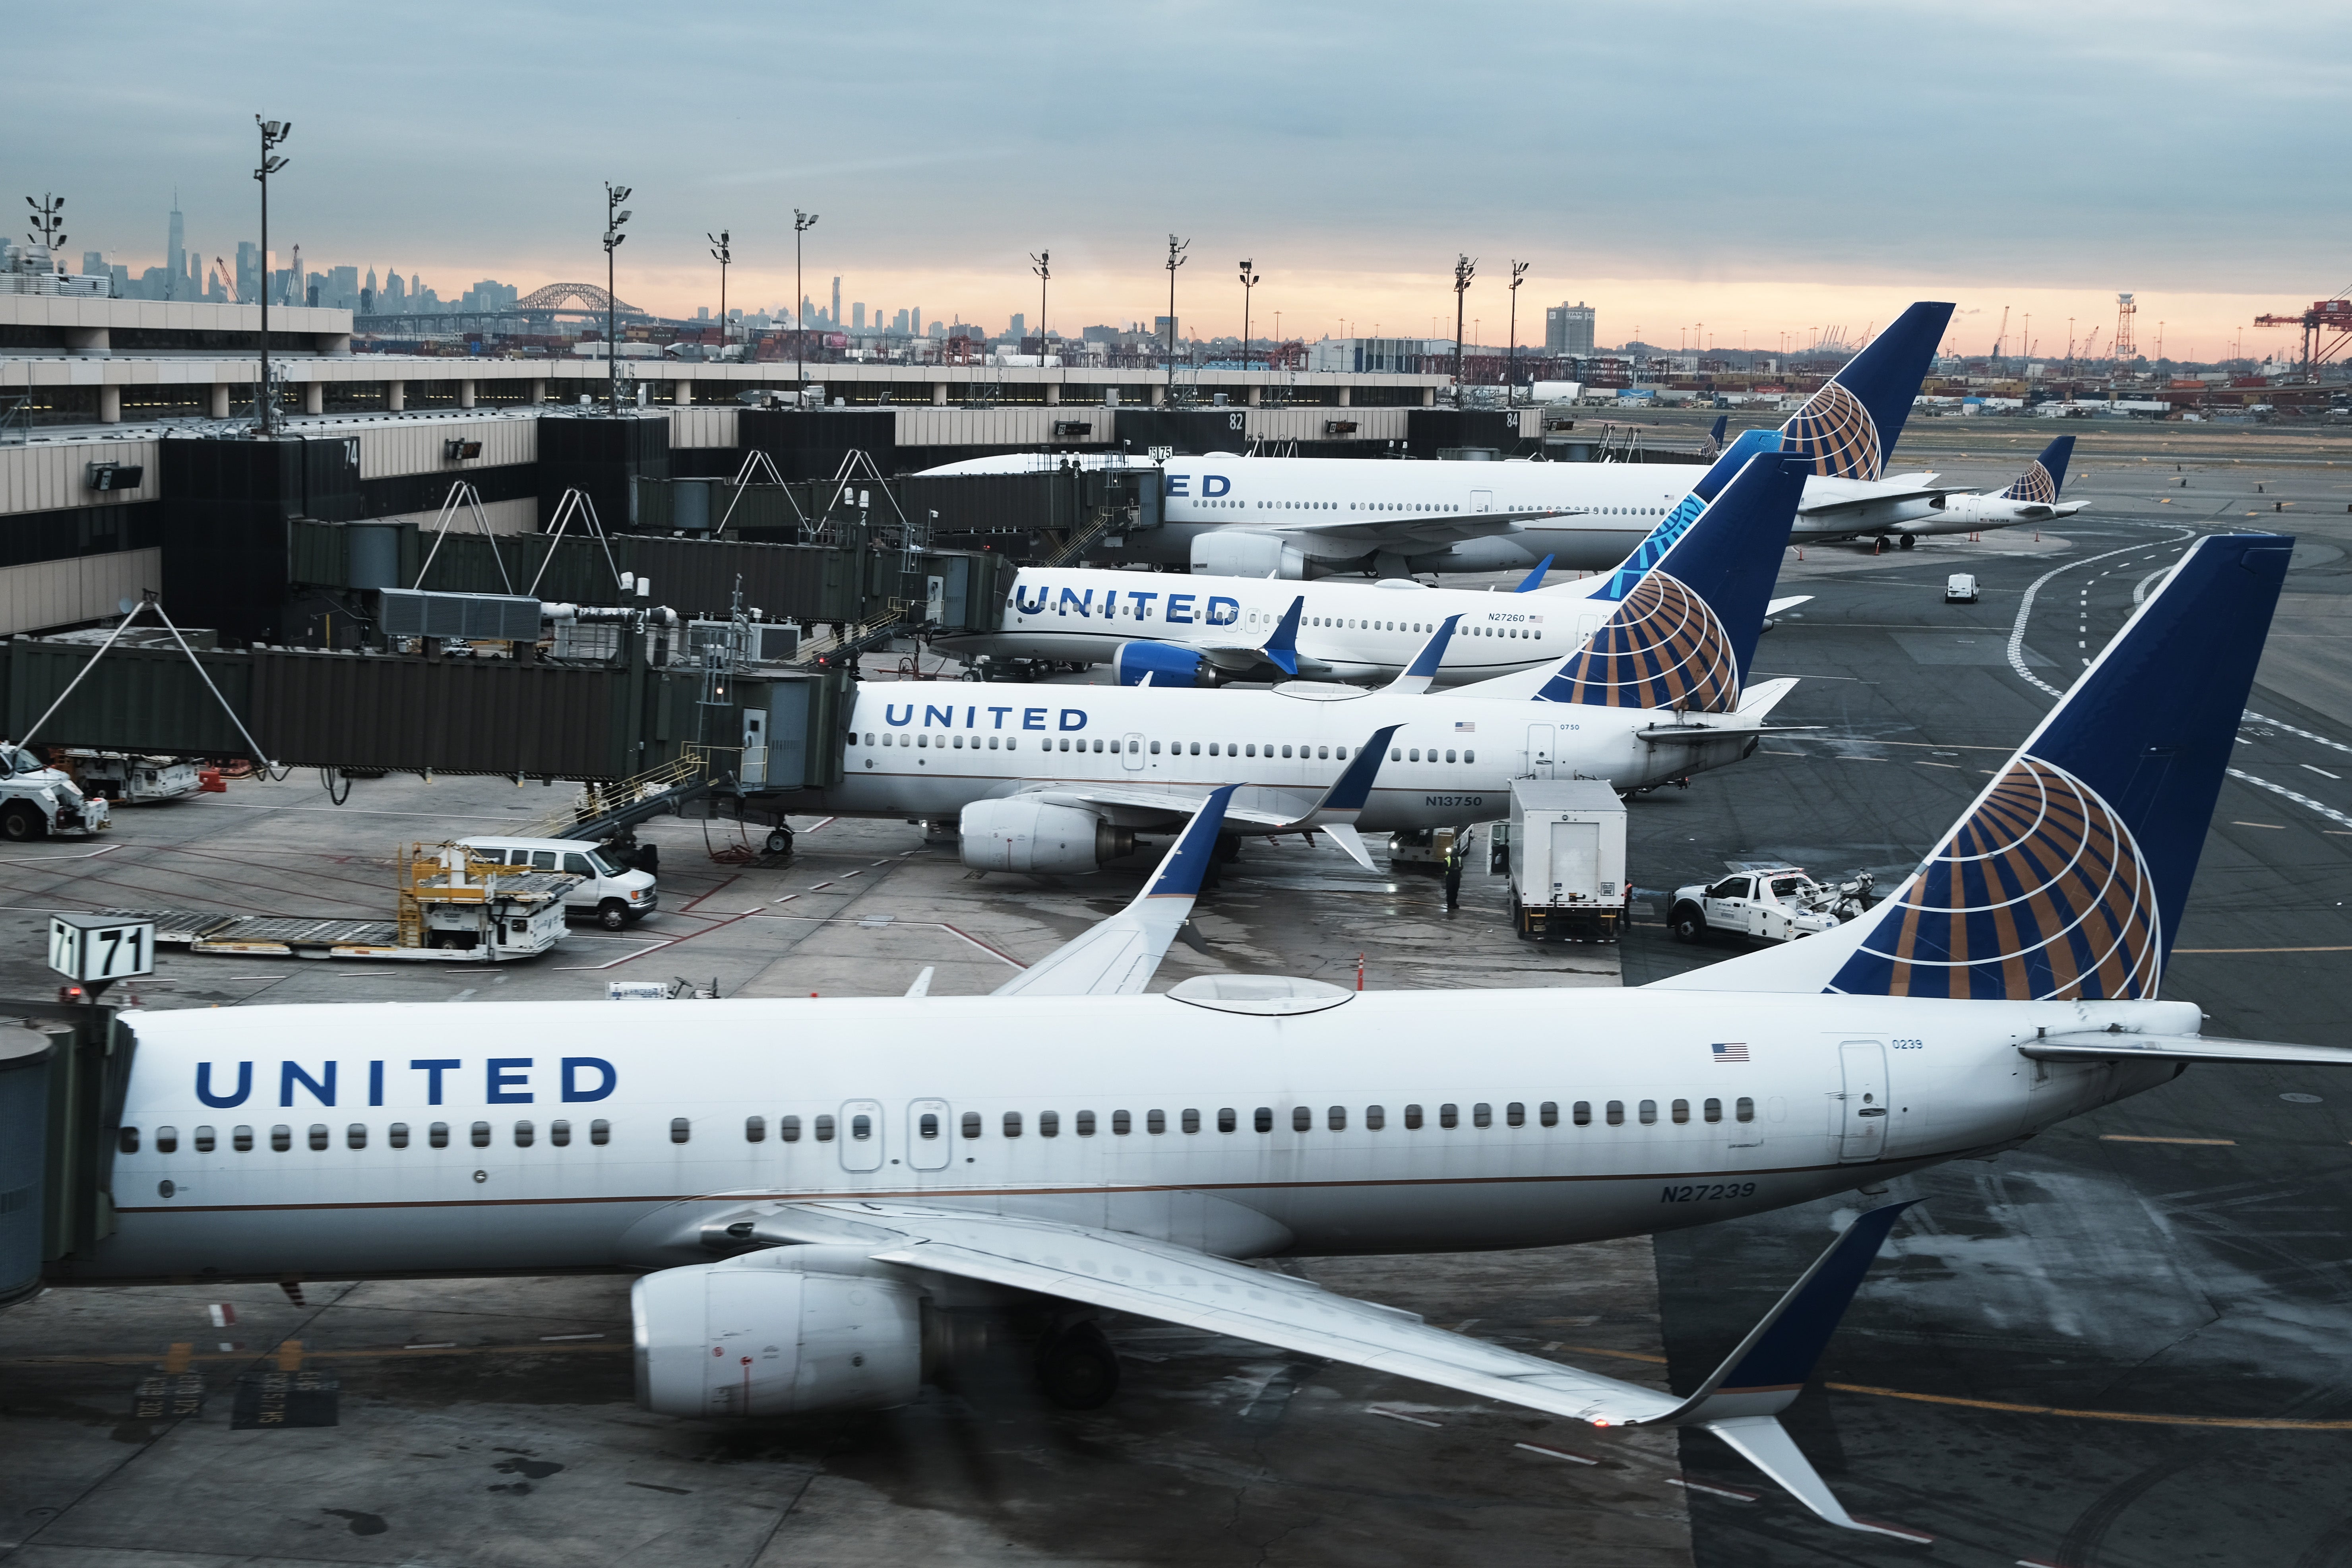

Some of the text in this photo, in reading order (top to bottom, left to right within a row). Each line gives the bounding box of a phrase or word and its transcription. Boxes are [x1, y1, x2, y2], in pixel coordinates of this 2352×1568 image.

[1229, 413, 1243, 430] 82
[1507, 413, 1518, 428] 84
[344, 440, 358, 469] 74
[1149, 447, 1156, 458] 75
[1160, 447, 1171, 458] 75
[1016, 585, 1240, 626] UNITED
[1488, 613, 1525, 622] N27260
[886, 704, 1087, 731] UNITED
[1426, 797, 1482, 806] N13750
[99, 927, 141, 976] 71
[1893, 1040, 1923, 1049] 0239
[195, 1056, 617, 1108] UNITED
[1661, 1182, 1756, 1203] N27239
